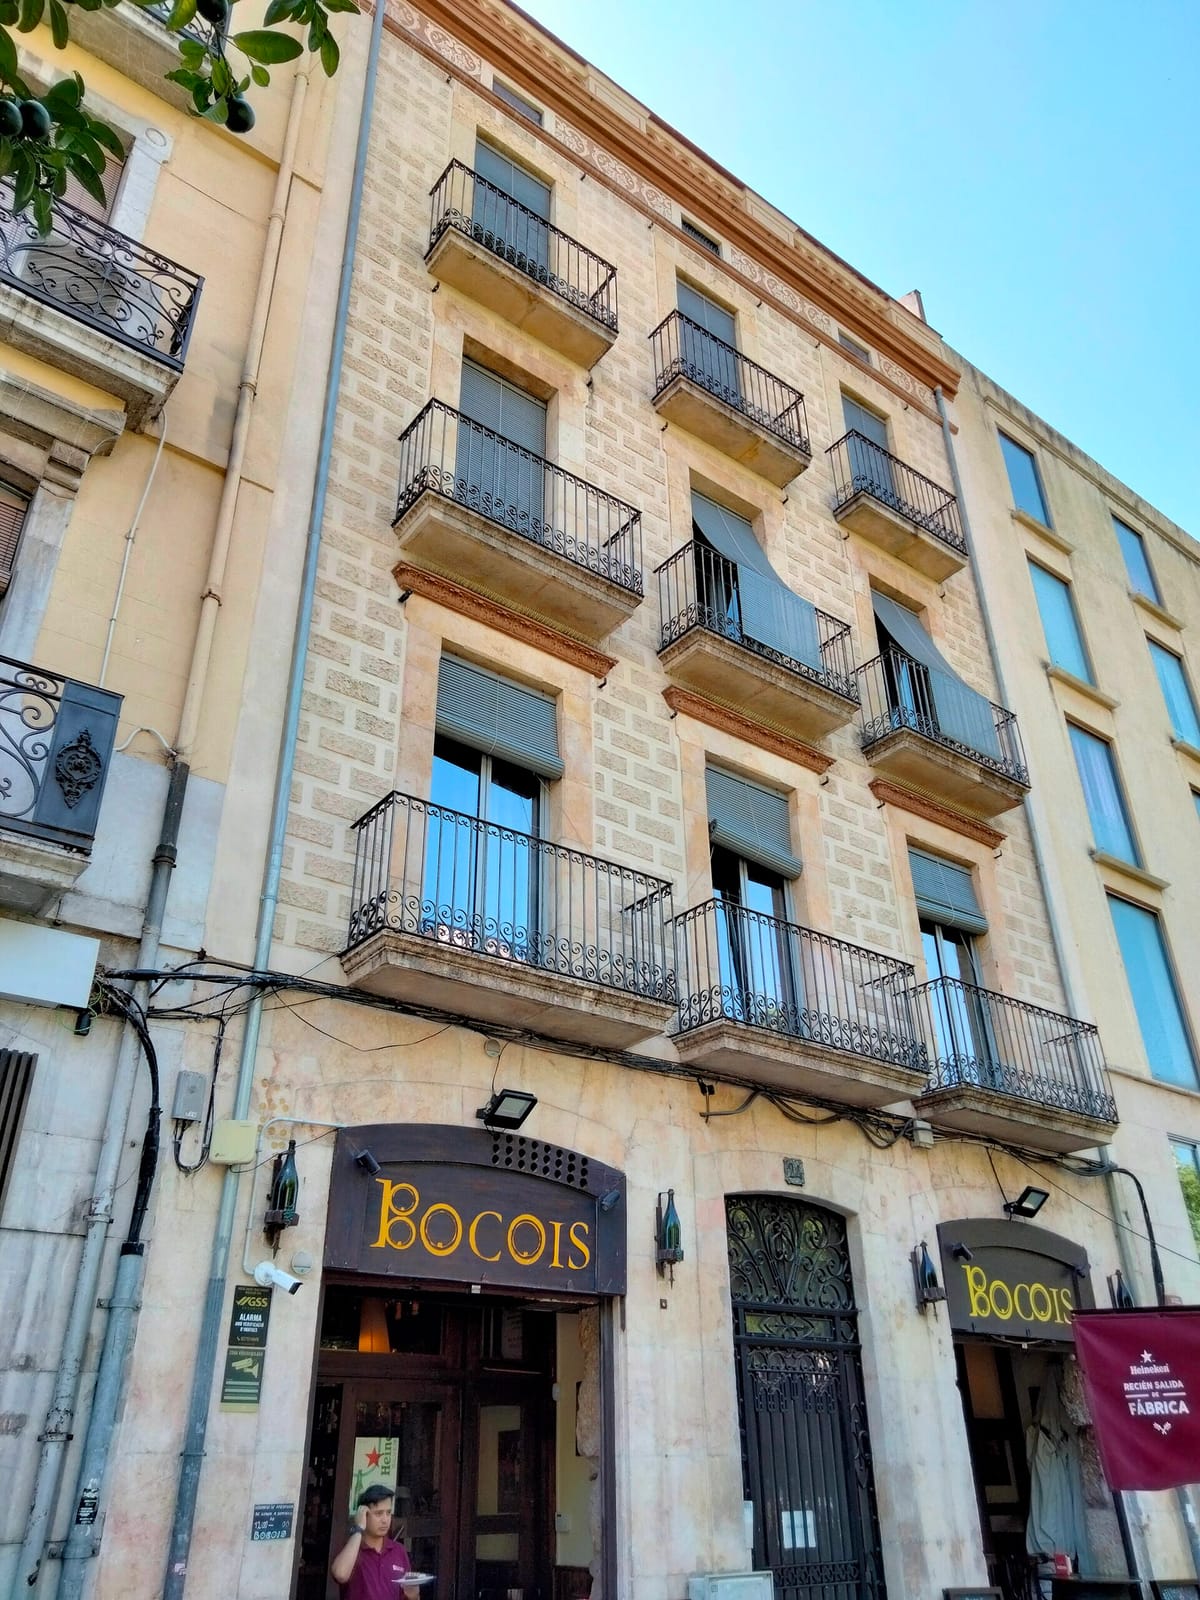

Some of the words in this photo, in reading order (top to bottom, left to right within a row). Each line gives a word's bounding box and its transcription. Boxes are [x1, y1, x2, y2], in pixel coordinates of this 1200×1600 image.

[369, 1178, 591, 1270] BOCOIS
[961, 1264, 1074, 1325] BOCOIS
[248, 1297, 268, 1307] GSS
[239, 1313, 262, 1321] ALARMA
[1129, 1364, 1170, 1375] Heineken
[1123, 1380, 1153, 1391] RECIÉN
[1154, 1380, 1184, 1390] SALIDA
[1128, 1399, 1190, 1416] FÁBRICA
